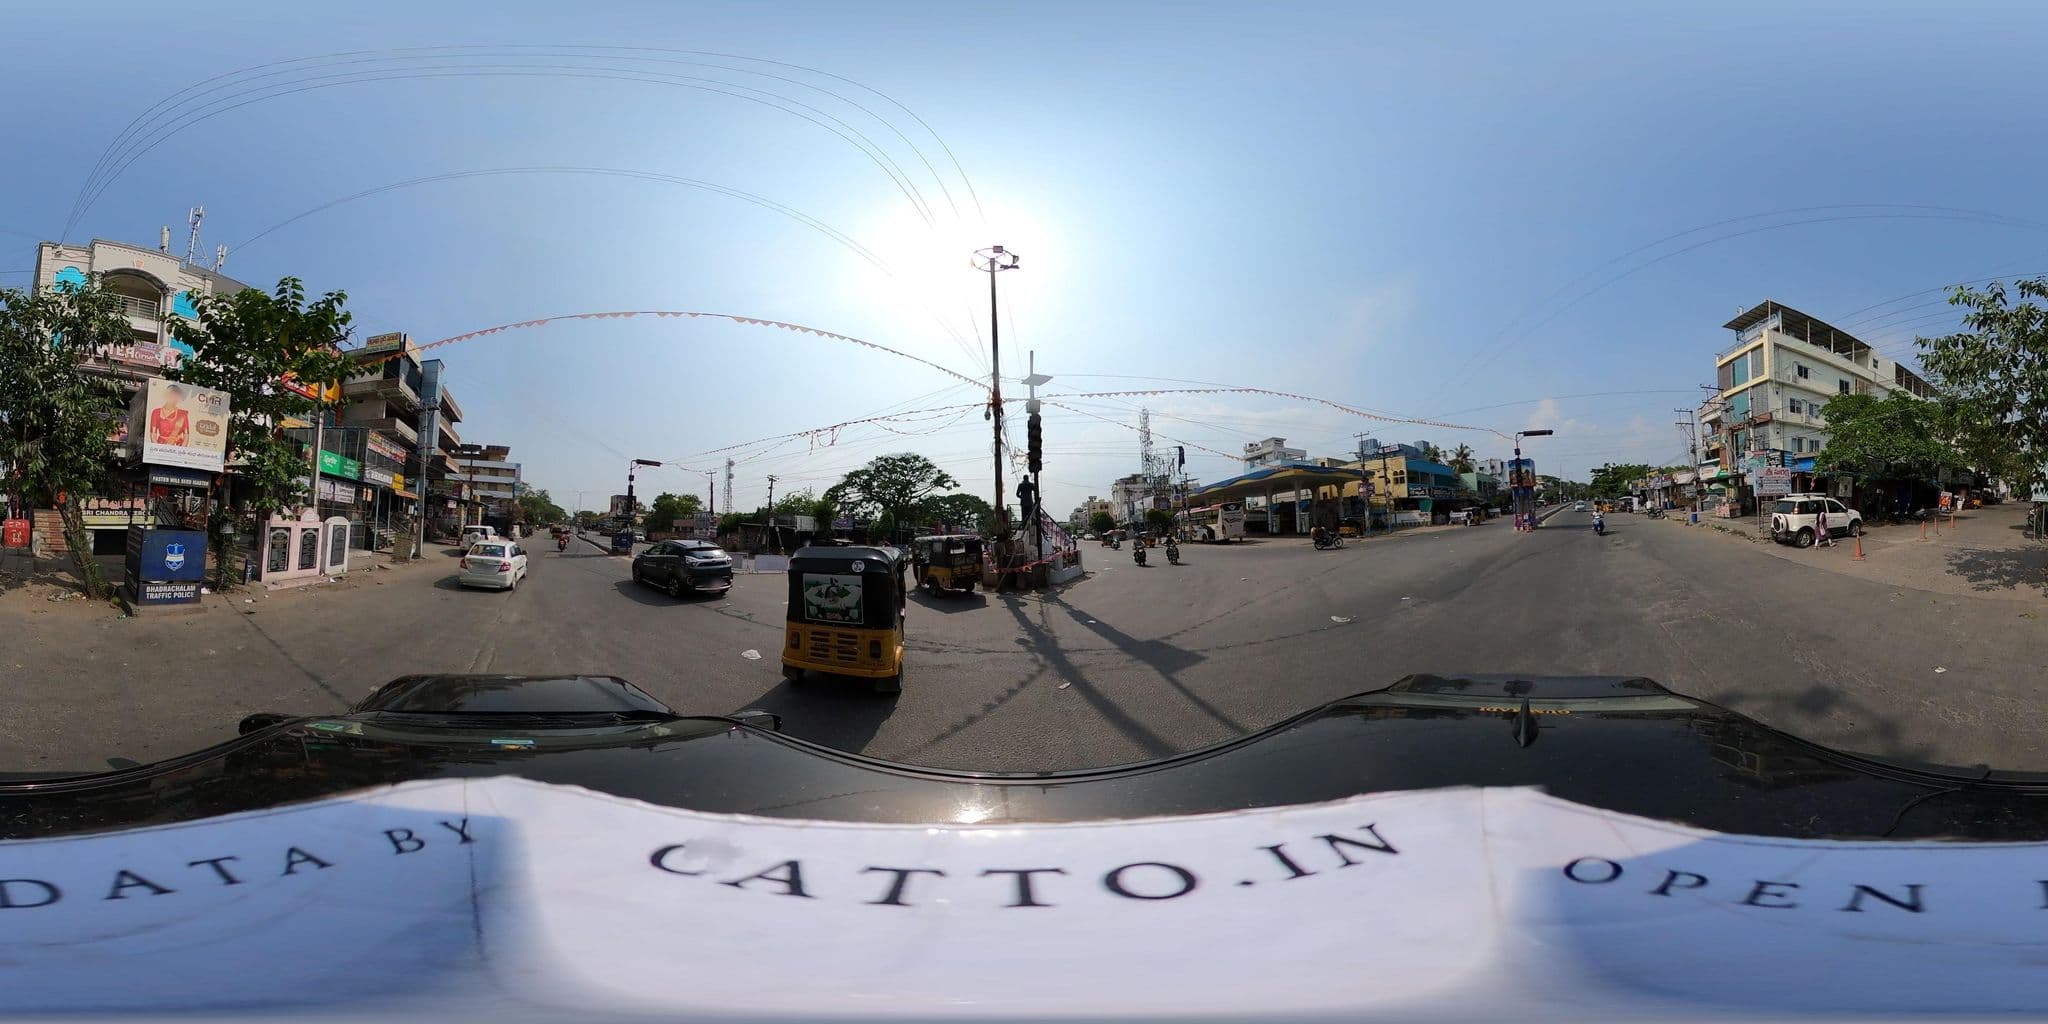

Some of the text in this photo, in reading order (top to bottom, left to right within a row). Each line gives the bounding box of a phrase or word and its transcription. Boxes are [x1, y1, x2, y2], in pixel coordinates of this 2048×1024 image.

[146, 585, 196, 593] BHADRACHALAM
[146, 591, 194, 600] TRAFFIC POLICE
[382, 818, 477, 855] BY
[1563, 856, 1928, 914] OPEN
